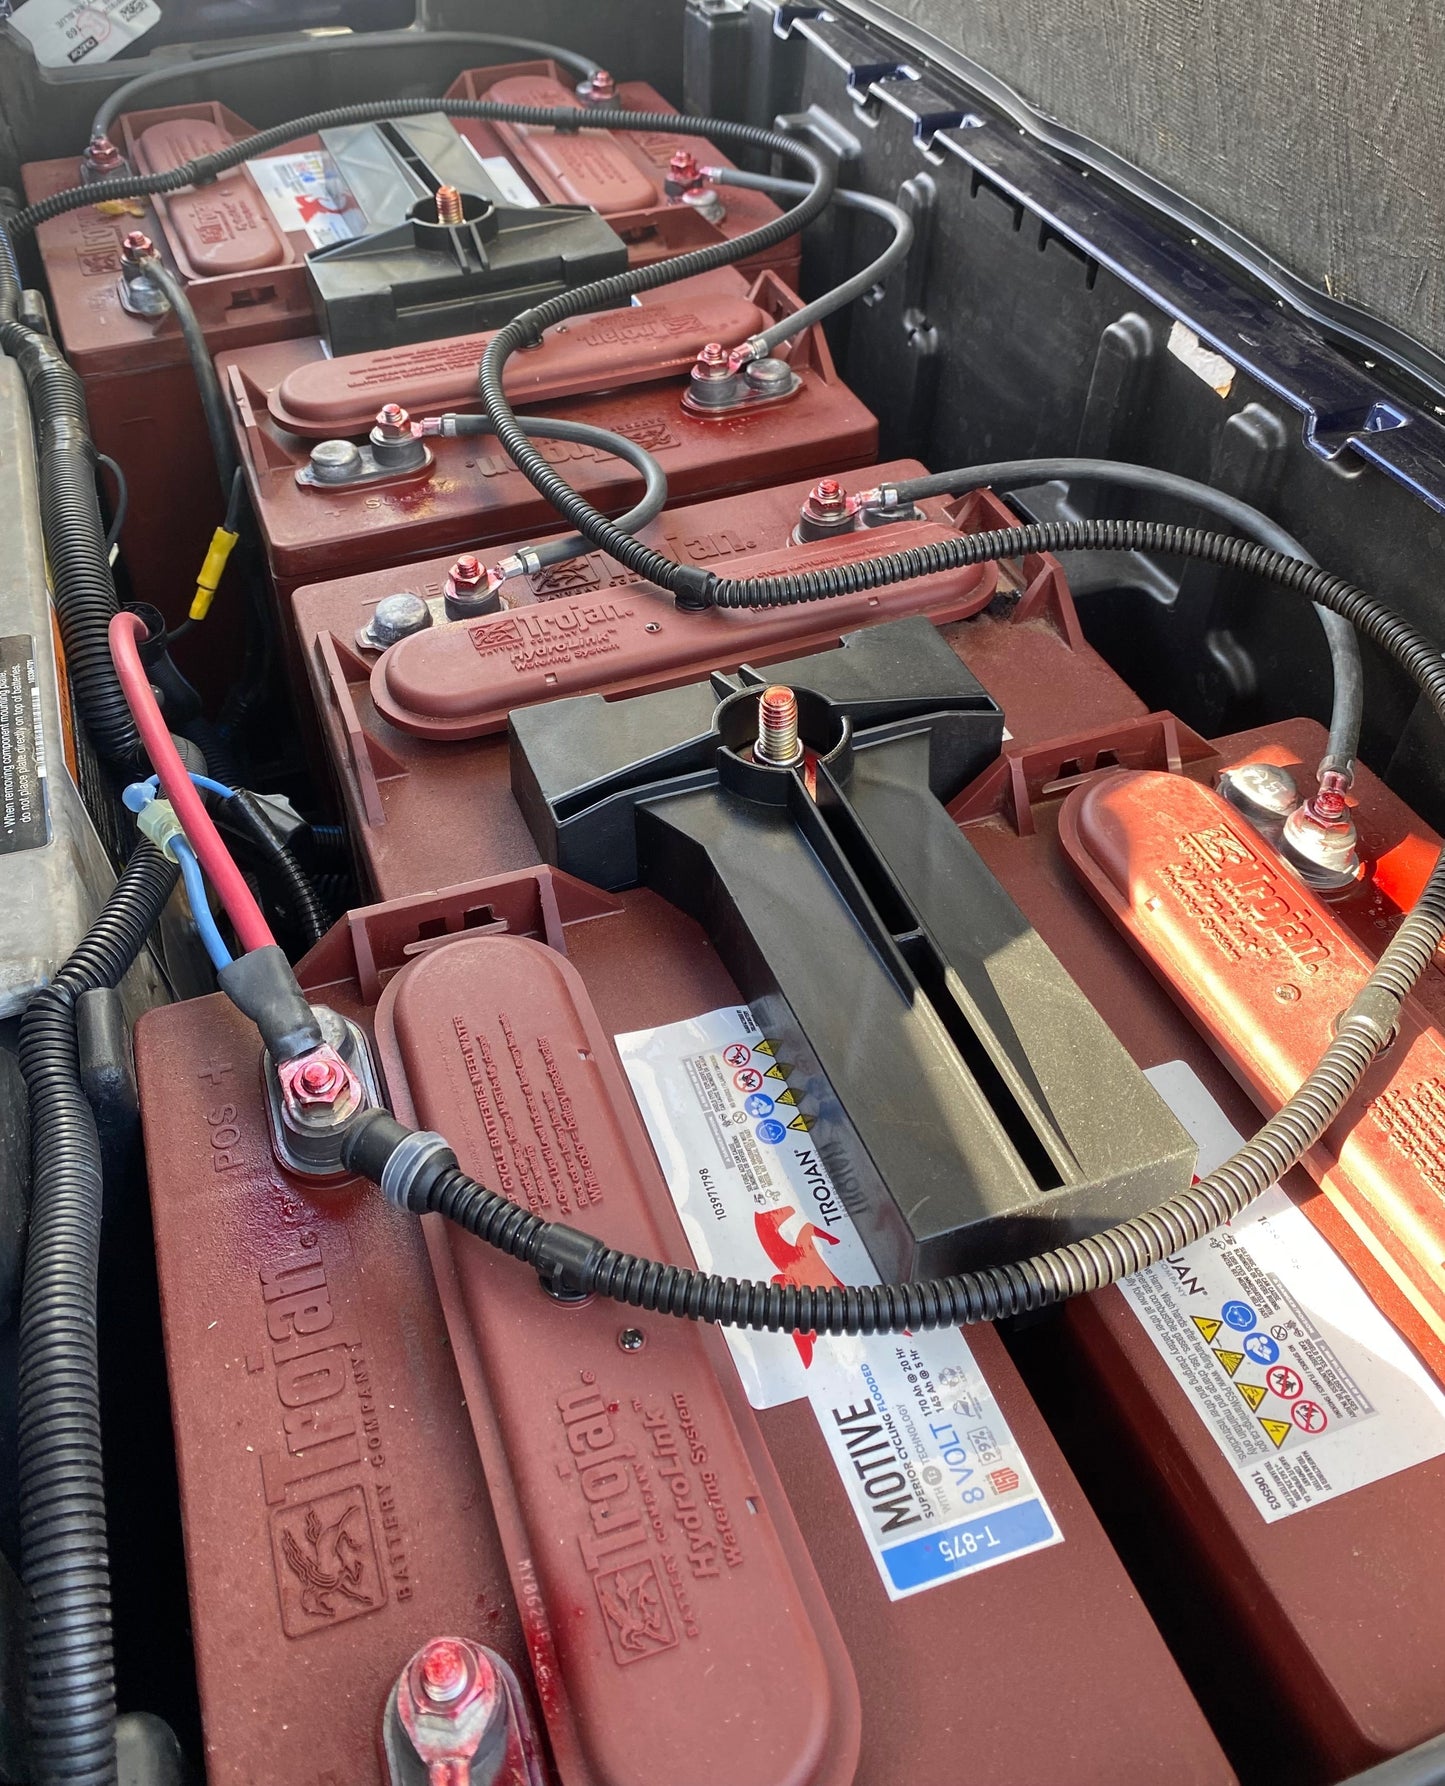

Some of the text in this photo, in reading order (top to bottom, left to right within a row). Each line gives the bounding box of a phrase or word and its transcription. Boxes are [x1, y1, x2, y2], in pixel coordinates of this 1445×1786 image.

[9, 661, 31, 823] do not place plate directly on top of batteries.
[1, 763, 15, 802] removing
[2, 799, 16, 829] When
[450, 1013, 475, 1053] WATER
[534, 1034, 556, 1065] water
[462, 1050, 484, 1084] NEED
[543, 1060, 567, 1096] needs
[469, 1082, 505, 1148] BATTERIES
[490, 1084, 510, 1114] MUST
[554, 1092, 581, 1132] battery
[206, 1102, 245, 1173] POS
[569, 1138, 592, 1169] color
[490, 1146, 516, 1190] CYCLE
[579, 1166, 604, 1204] White
[699, 1167, 727, 1220] 103971798
[1129, 1285, 1150, 1306] follow
[1260, 1276, 1271, 1287] CAN
[1142, 1305, 1156, 1315] all
[1146, 1274, 1166, 1293] Harm.
[1158, 1292, 1177, 1309] Wash
[1168, 1307, 1191, 1329] hands
[1181, 1327, 1199, 1342] after
[1147, 1293, 1181, 1332] combustible
[1147, 1314, 1167, 1333] other
[1157, 1331, 1183, 1357] battery
[1170, 1332, 1193, 1355] gases.
[1185, 1353, 1204, 1370] Use,
[1286, 1344, 1297, 1353] NO
[1291, 1351, 1310, 1372] SPARKS
[891, 1344, 933, 1417] 170 Ah @ 20 Hr
[907, 1346, 945, 1414] 145 Ah @ 5 Hr
[1171, 1354, 1201, 1386] charging
[1194, 1368, 1219, 1394] charge
[1306, 1373, 1325, 1394] FLAMES
[1193, 1384, 1210, 1400] and
[1202, 1398, 1222, 1418] other
[1211, 1393, 1229, 1408] and
[1322, 1396, 1344, 1420] SMOKING
[859, 1360, 934, 1519] SUPERIOR CYCLING FLOODED
[1214, 1418, 1250, 1461] instructions.
[1221, 1407, 1250, 1439] maintain
[895, 1399, 952, 1513] WITH TECHNOLOGY
[928, 1414, 977, 1487] VOLT
[971, 1428, 997, 1464] 99%
[1239, 1438, 1259, 1455] only
[349, 1352, 414, 1600] BATTERY COMPANY
[668, 1386, 745, 1569] Watering System
[831, 1393, 922, 1536] MOTIVE
[959, 1484, 985, 1506] 8
[1250, 1470, 1282, 1511] 106503
[630, 1457, 700, 1640] BATTERY COMPANY
[937, 1523, 1001, 1564] T-875
